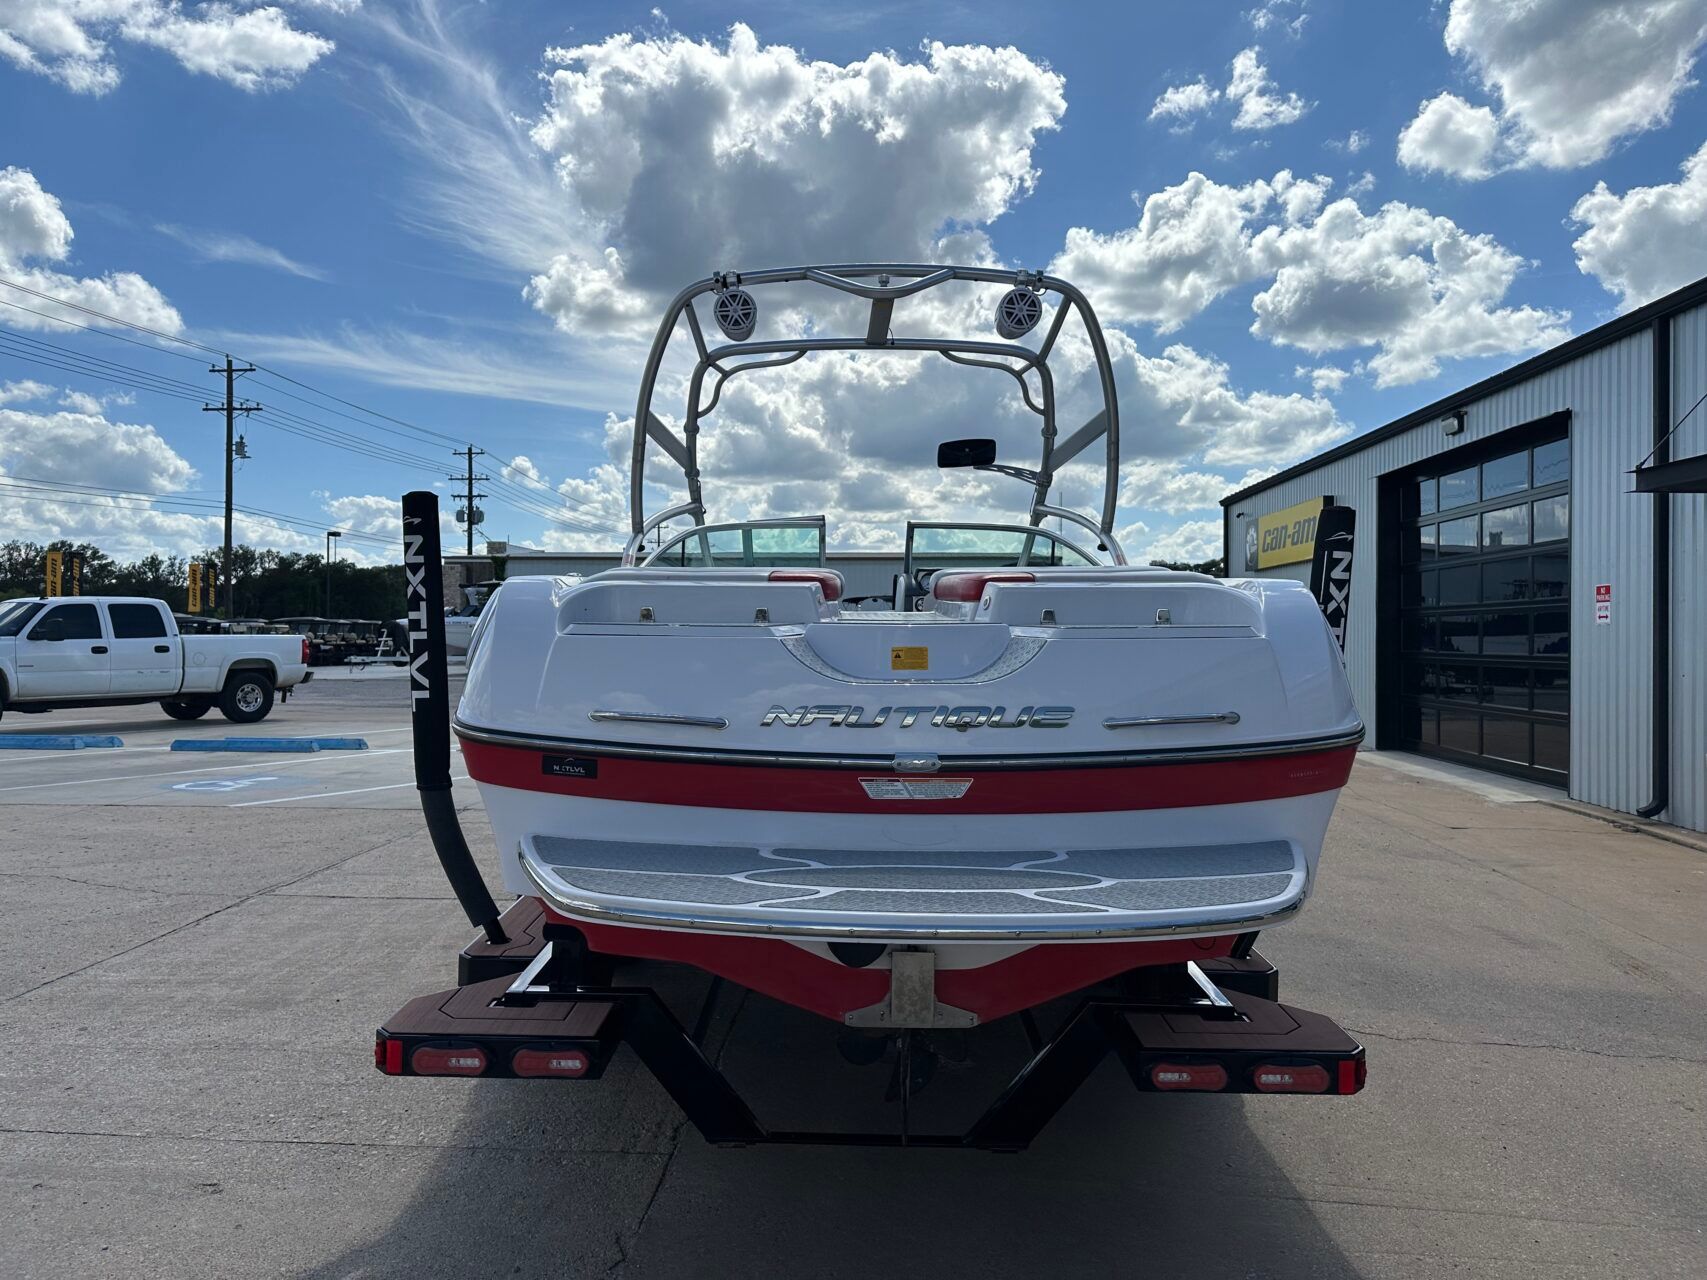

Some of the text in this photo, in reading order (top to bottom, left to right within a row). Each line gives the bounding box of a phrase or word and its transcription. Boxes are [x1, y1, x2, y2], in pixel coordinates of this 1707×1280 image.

[1261, 515, 1317, 552] can-am
[404, 534, 430, 712] NXTLVL
[760, 704, 1075, 732] NAUTIQUE
